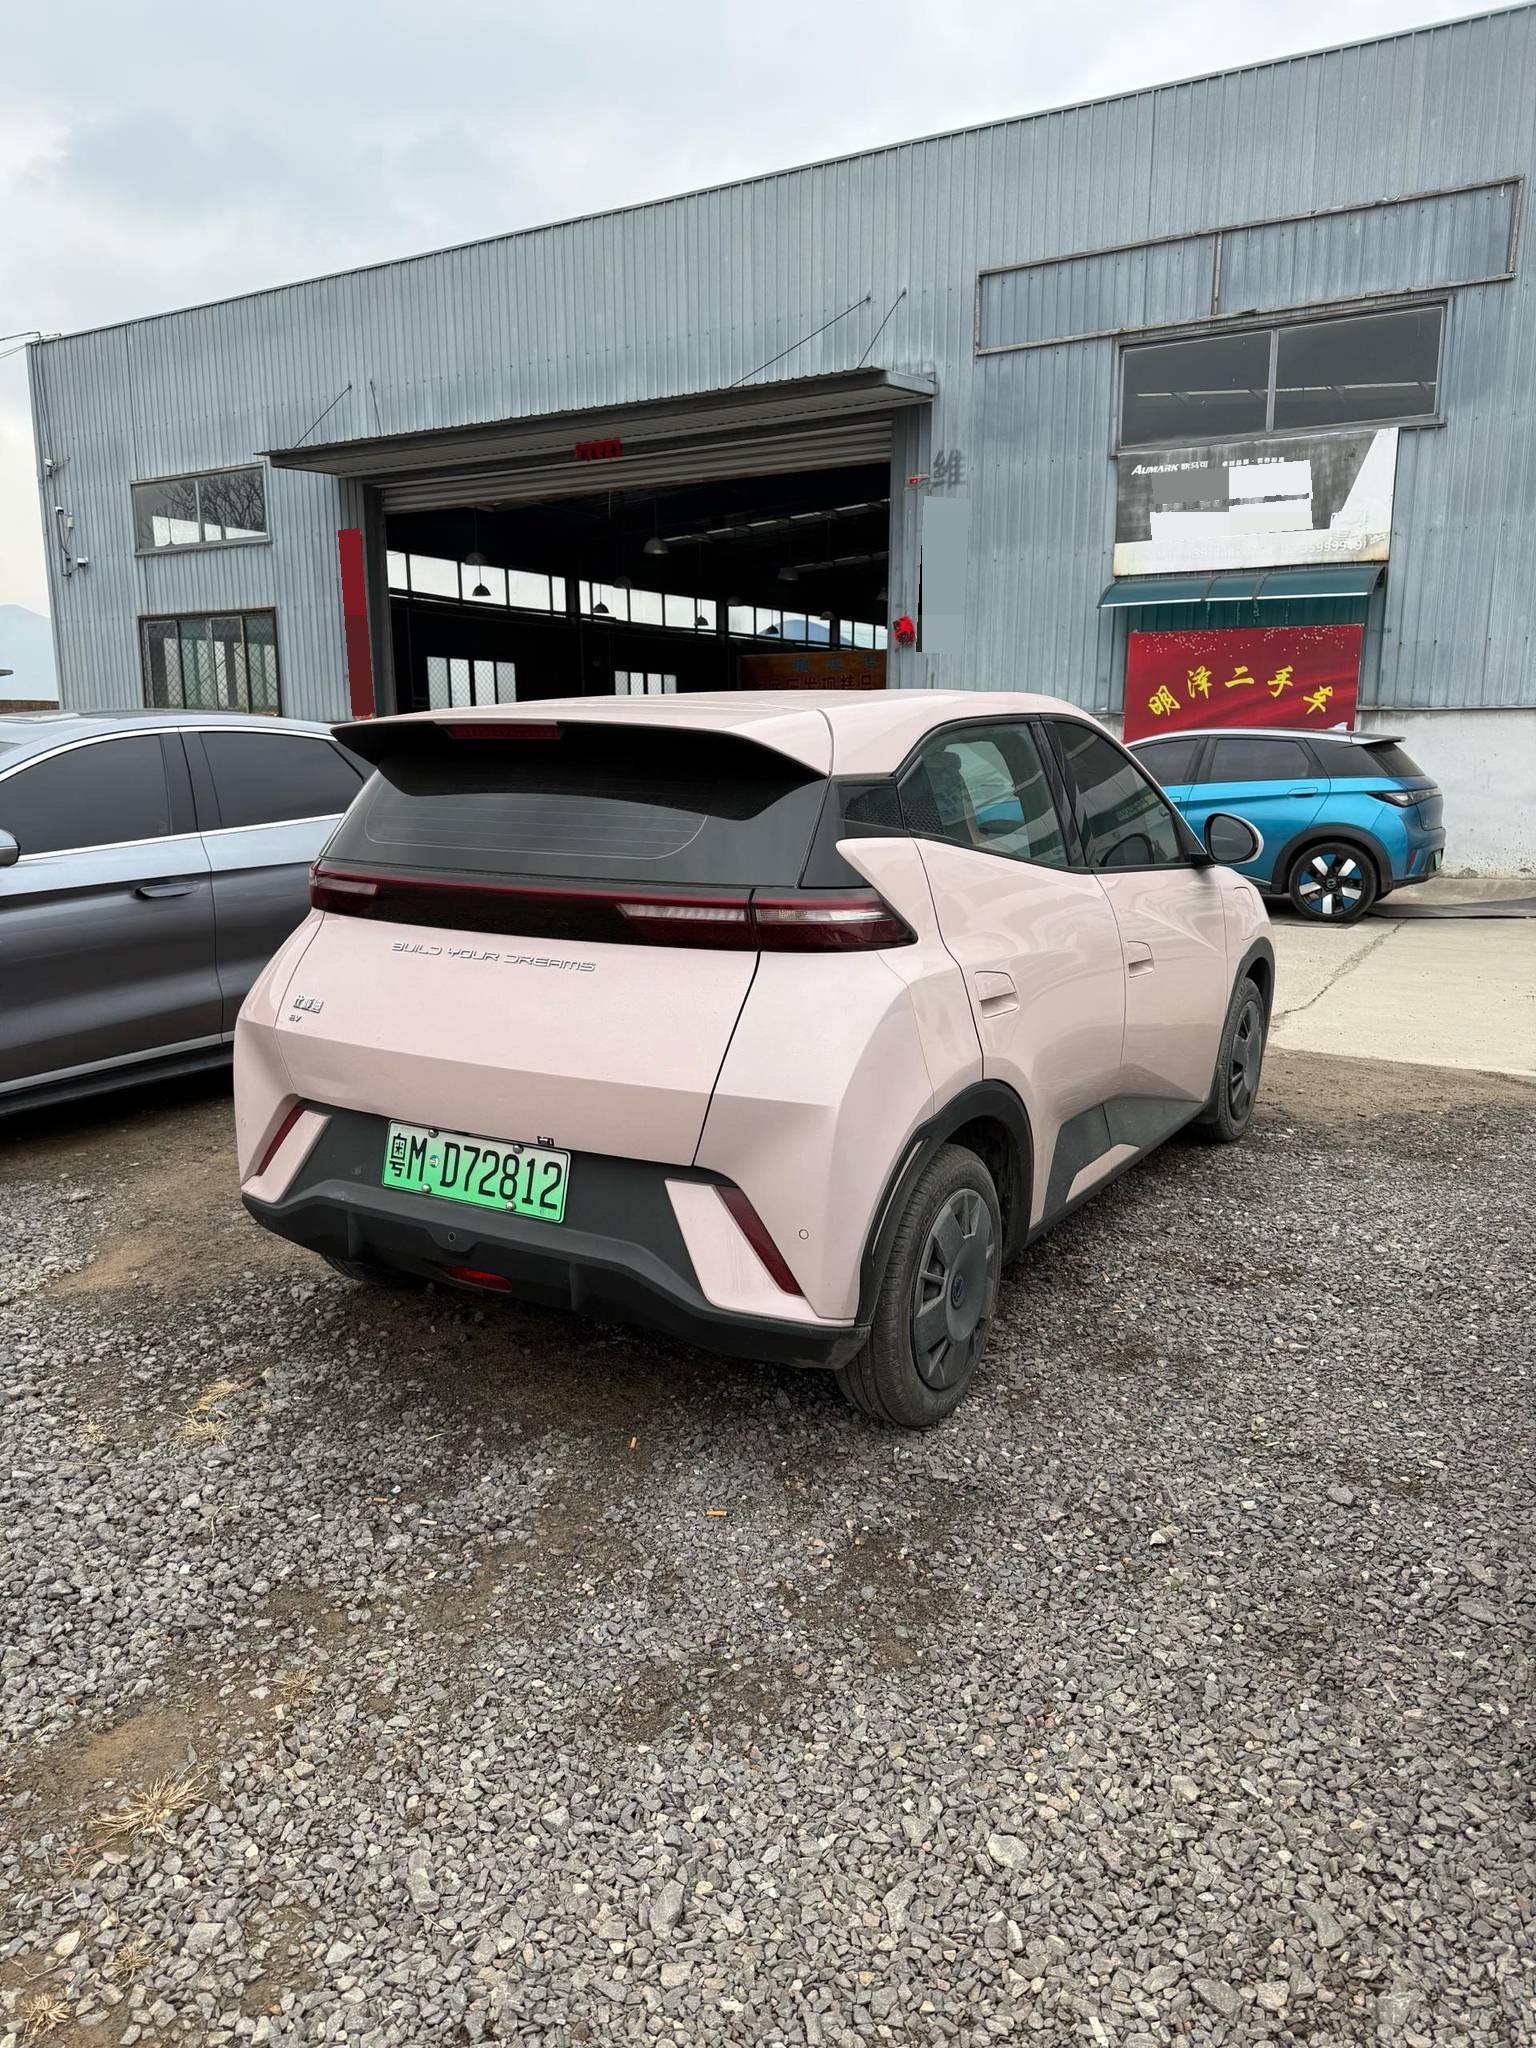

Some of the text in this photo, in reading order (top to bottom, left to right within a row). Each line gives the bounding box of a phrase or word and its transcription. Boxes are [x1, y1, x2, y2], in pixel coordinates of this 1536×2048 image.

[1131, 463, 1179, 475] AUMARK
[1148, 665, 1333, 716] 明泽二手车
[391, 942, 597, 972] BUILD YOUR DREAMS
